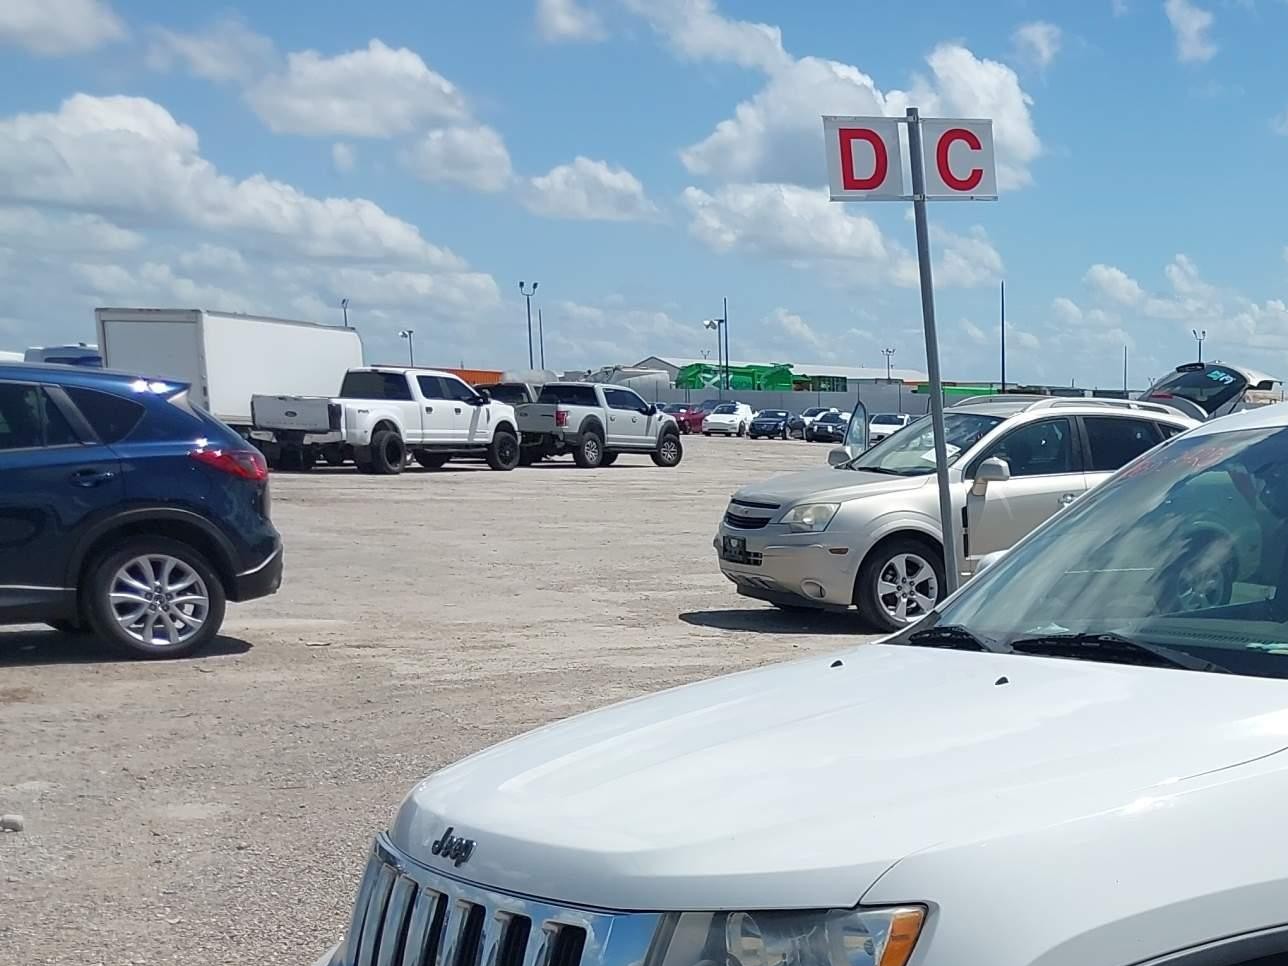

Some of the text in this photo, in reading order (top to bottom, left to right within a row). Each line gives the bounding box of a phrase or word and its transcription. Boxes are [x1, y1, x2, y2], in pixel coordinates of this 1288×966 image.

[838, 127, 888, 191] D
[936, 127, 984, 191] C
[431, 826, 477, 868] Jeep
